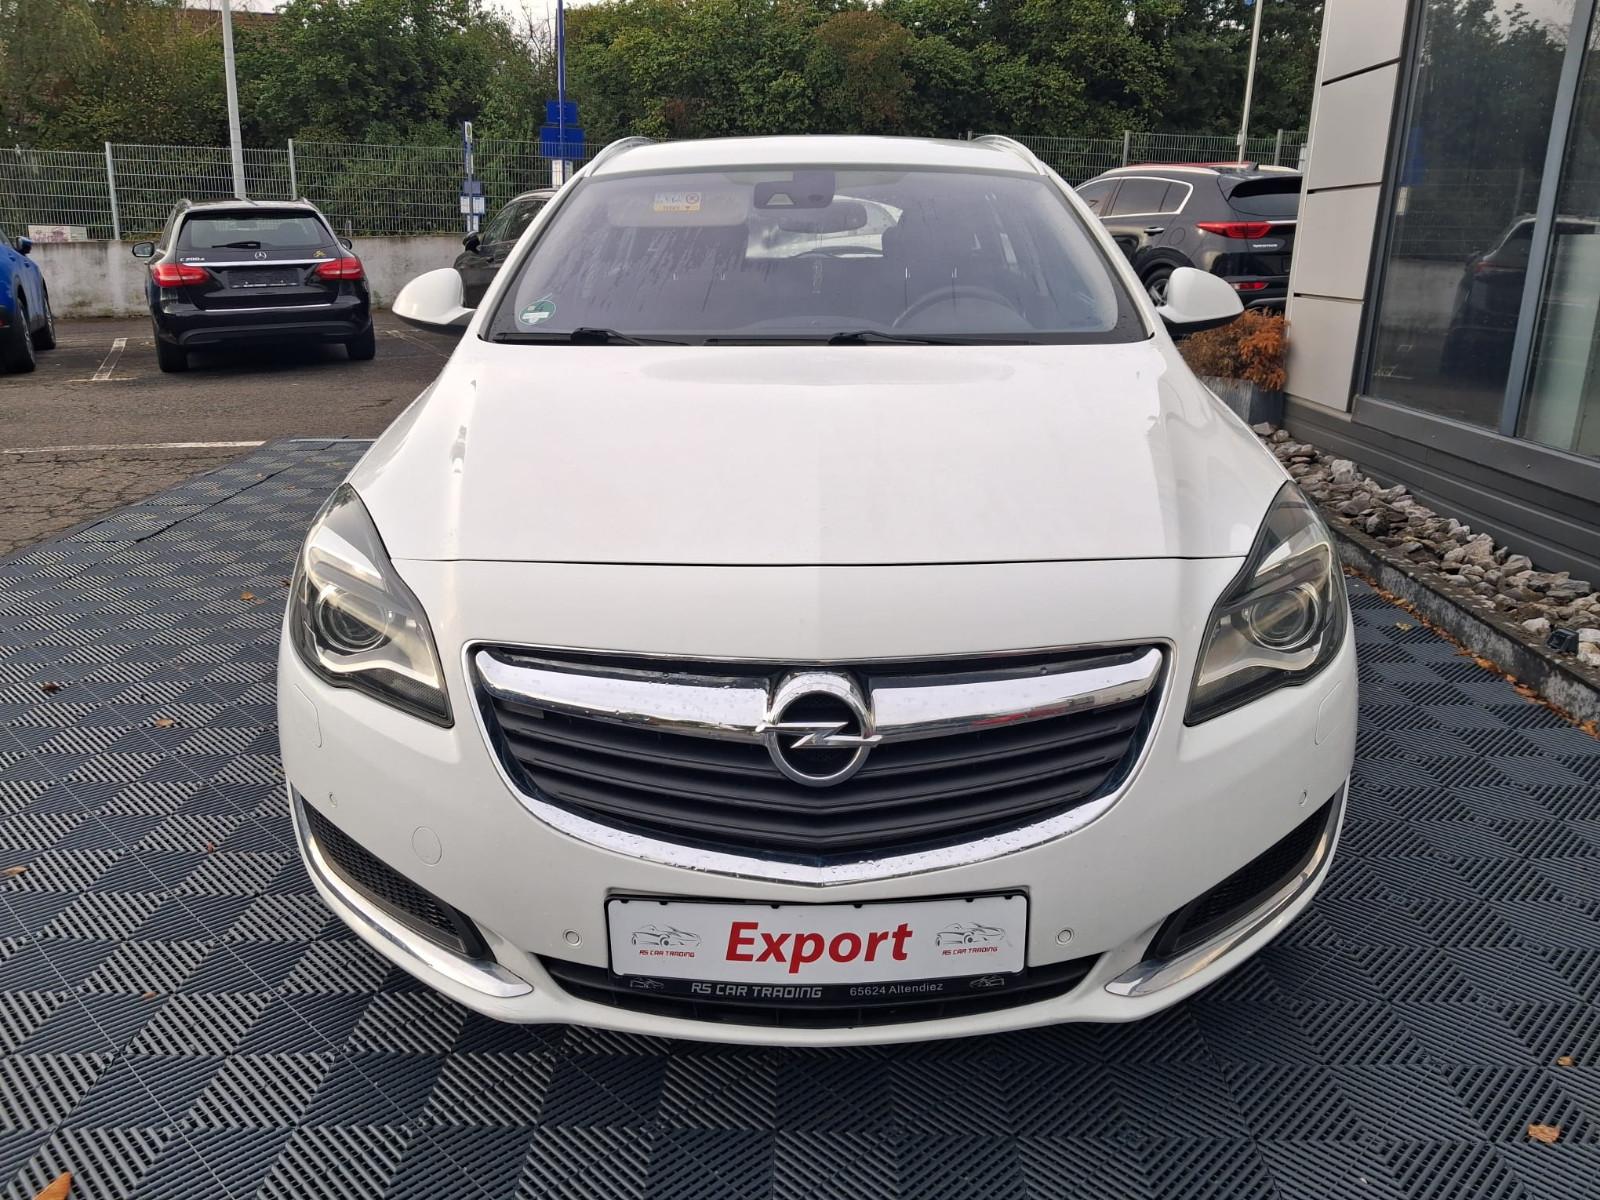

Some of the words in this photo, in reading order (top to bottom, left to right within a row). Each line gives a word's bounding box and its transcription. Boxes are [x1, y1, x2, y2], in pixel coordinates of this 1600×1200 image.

[725, 921, 913, 975] Export
[691, 982, 712, 994] RS
[716, 984, 748, 997] CAR
[752, 986, 823, 998] TRADING
[849, 986, 886, 996] 65624
[888, 983, 944, 994] Altendiez
